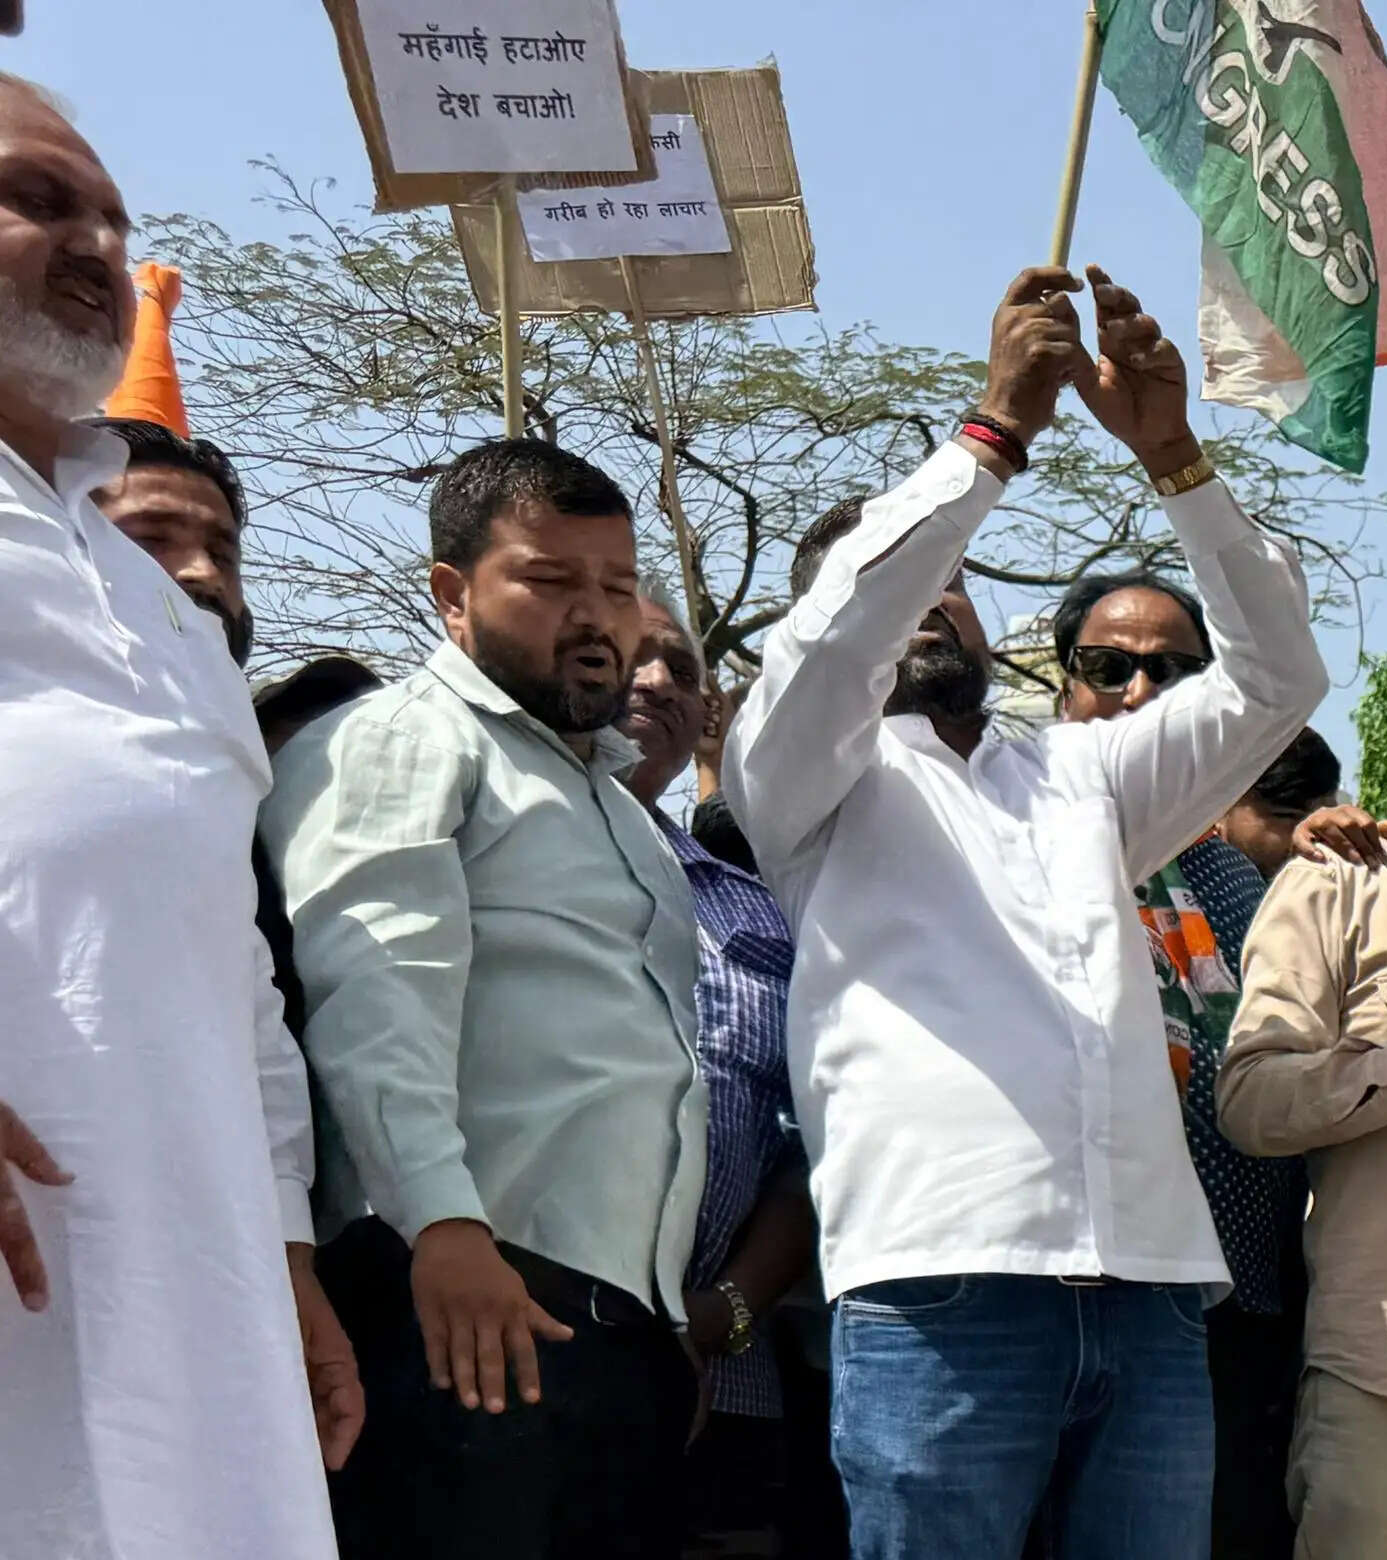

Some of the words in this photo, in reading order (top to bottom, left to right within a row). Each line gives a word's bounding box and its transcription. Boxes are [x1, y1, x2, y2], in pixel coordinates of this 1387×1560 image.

[398, 24, 488, 65] महँगाई
[437, 85, 481, 120] देश
[543, 202, 587, 222] गरीब
[596, 198, 616, 219] हो
[622, 201, 649, 219] रहा
[658, 201, 708, 217] लाचार
